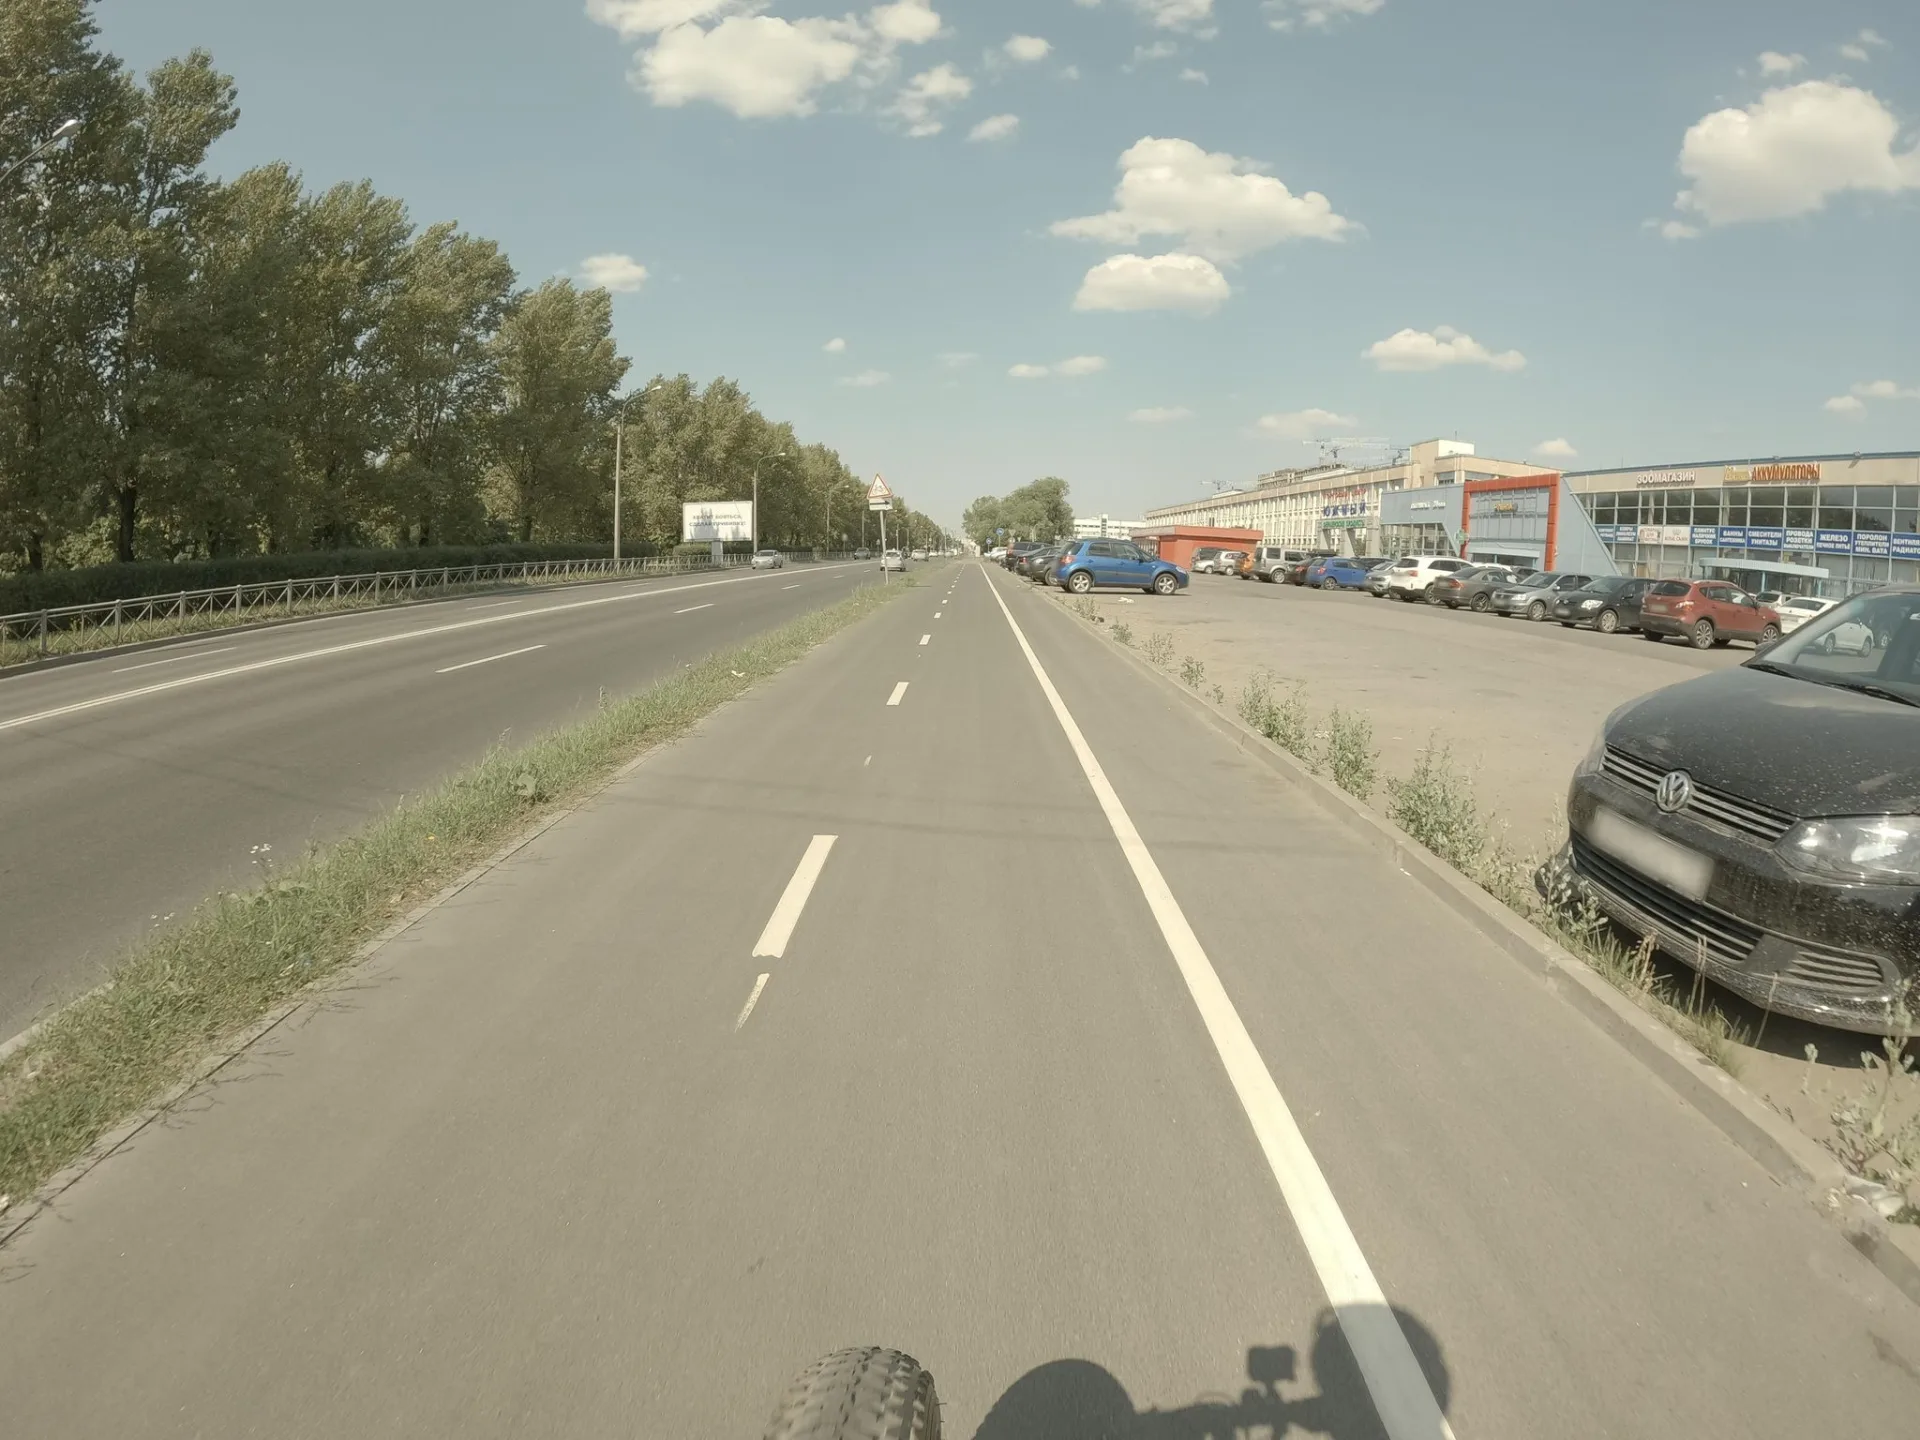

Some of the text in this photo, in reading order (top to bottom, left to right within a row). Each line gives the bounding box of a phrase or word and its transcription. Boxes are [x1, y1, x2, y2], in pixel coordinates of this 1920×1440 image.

[1752, 463, 1820, 481] АККУМУЛЯТОРЫ
[1636, 471, 1695, 485] ЗООМАГАЗИН
[1323, 499, 1366, 517] ЮЖНЫЙ
[1748, 530, 1782, 538] СМЕСИТЕЛИ
[1857, 533, 1887, 541] ПОРОЛОН
[1751, 538, 1778, 546] УНИТАЗЫ
[1820, 534, 1849, 543] ЖЕЛЕЗО
[1872, 547, 1888, 555] ВАТА
